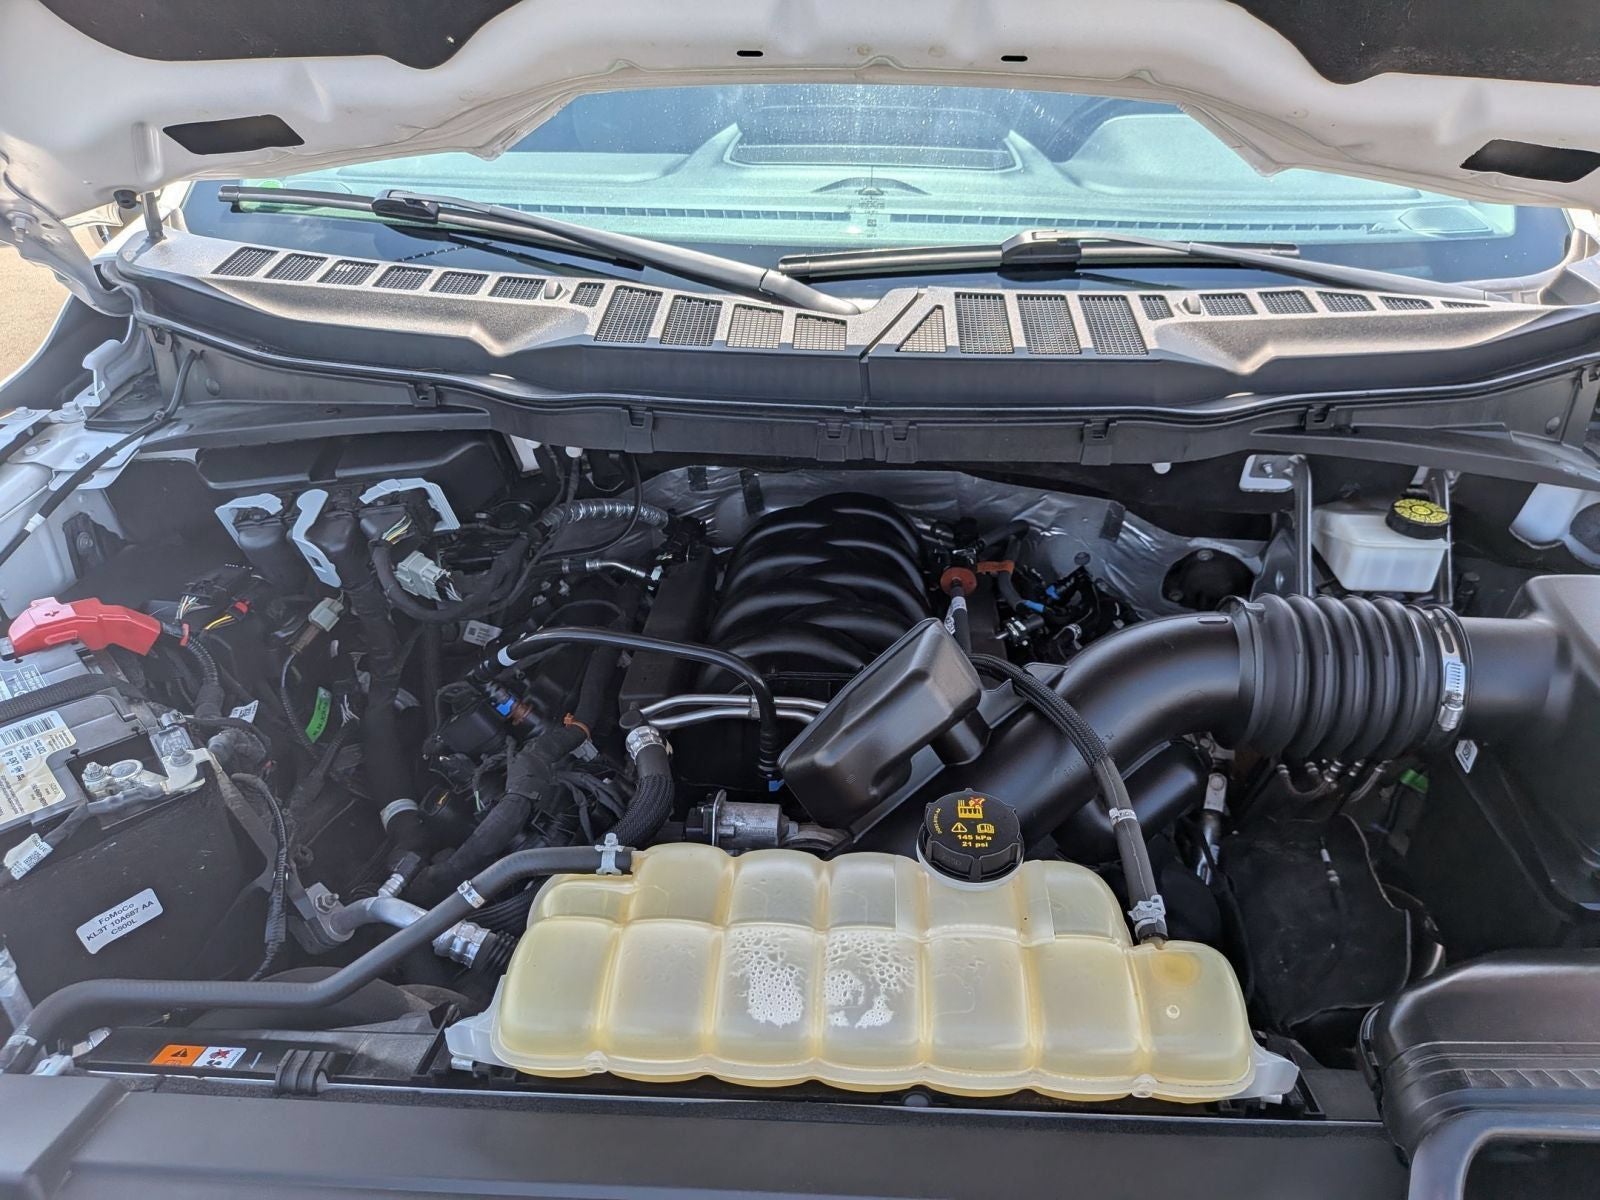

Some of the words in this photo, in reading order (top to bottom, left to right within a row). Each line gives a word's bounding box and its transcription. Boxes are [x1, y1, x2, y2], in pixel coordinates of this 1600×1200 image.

[86, 924, 109, 941] KL3T
[141, 900, 154, 910] AA
[98, 903, 135, 925] FoMoCo
